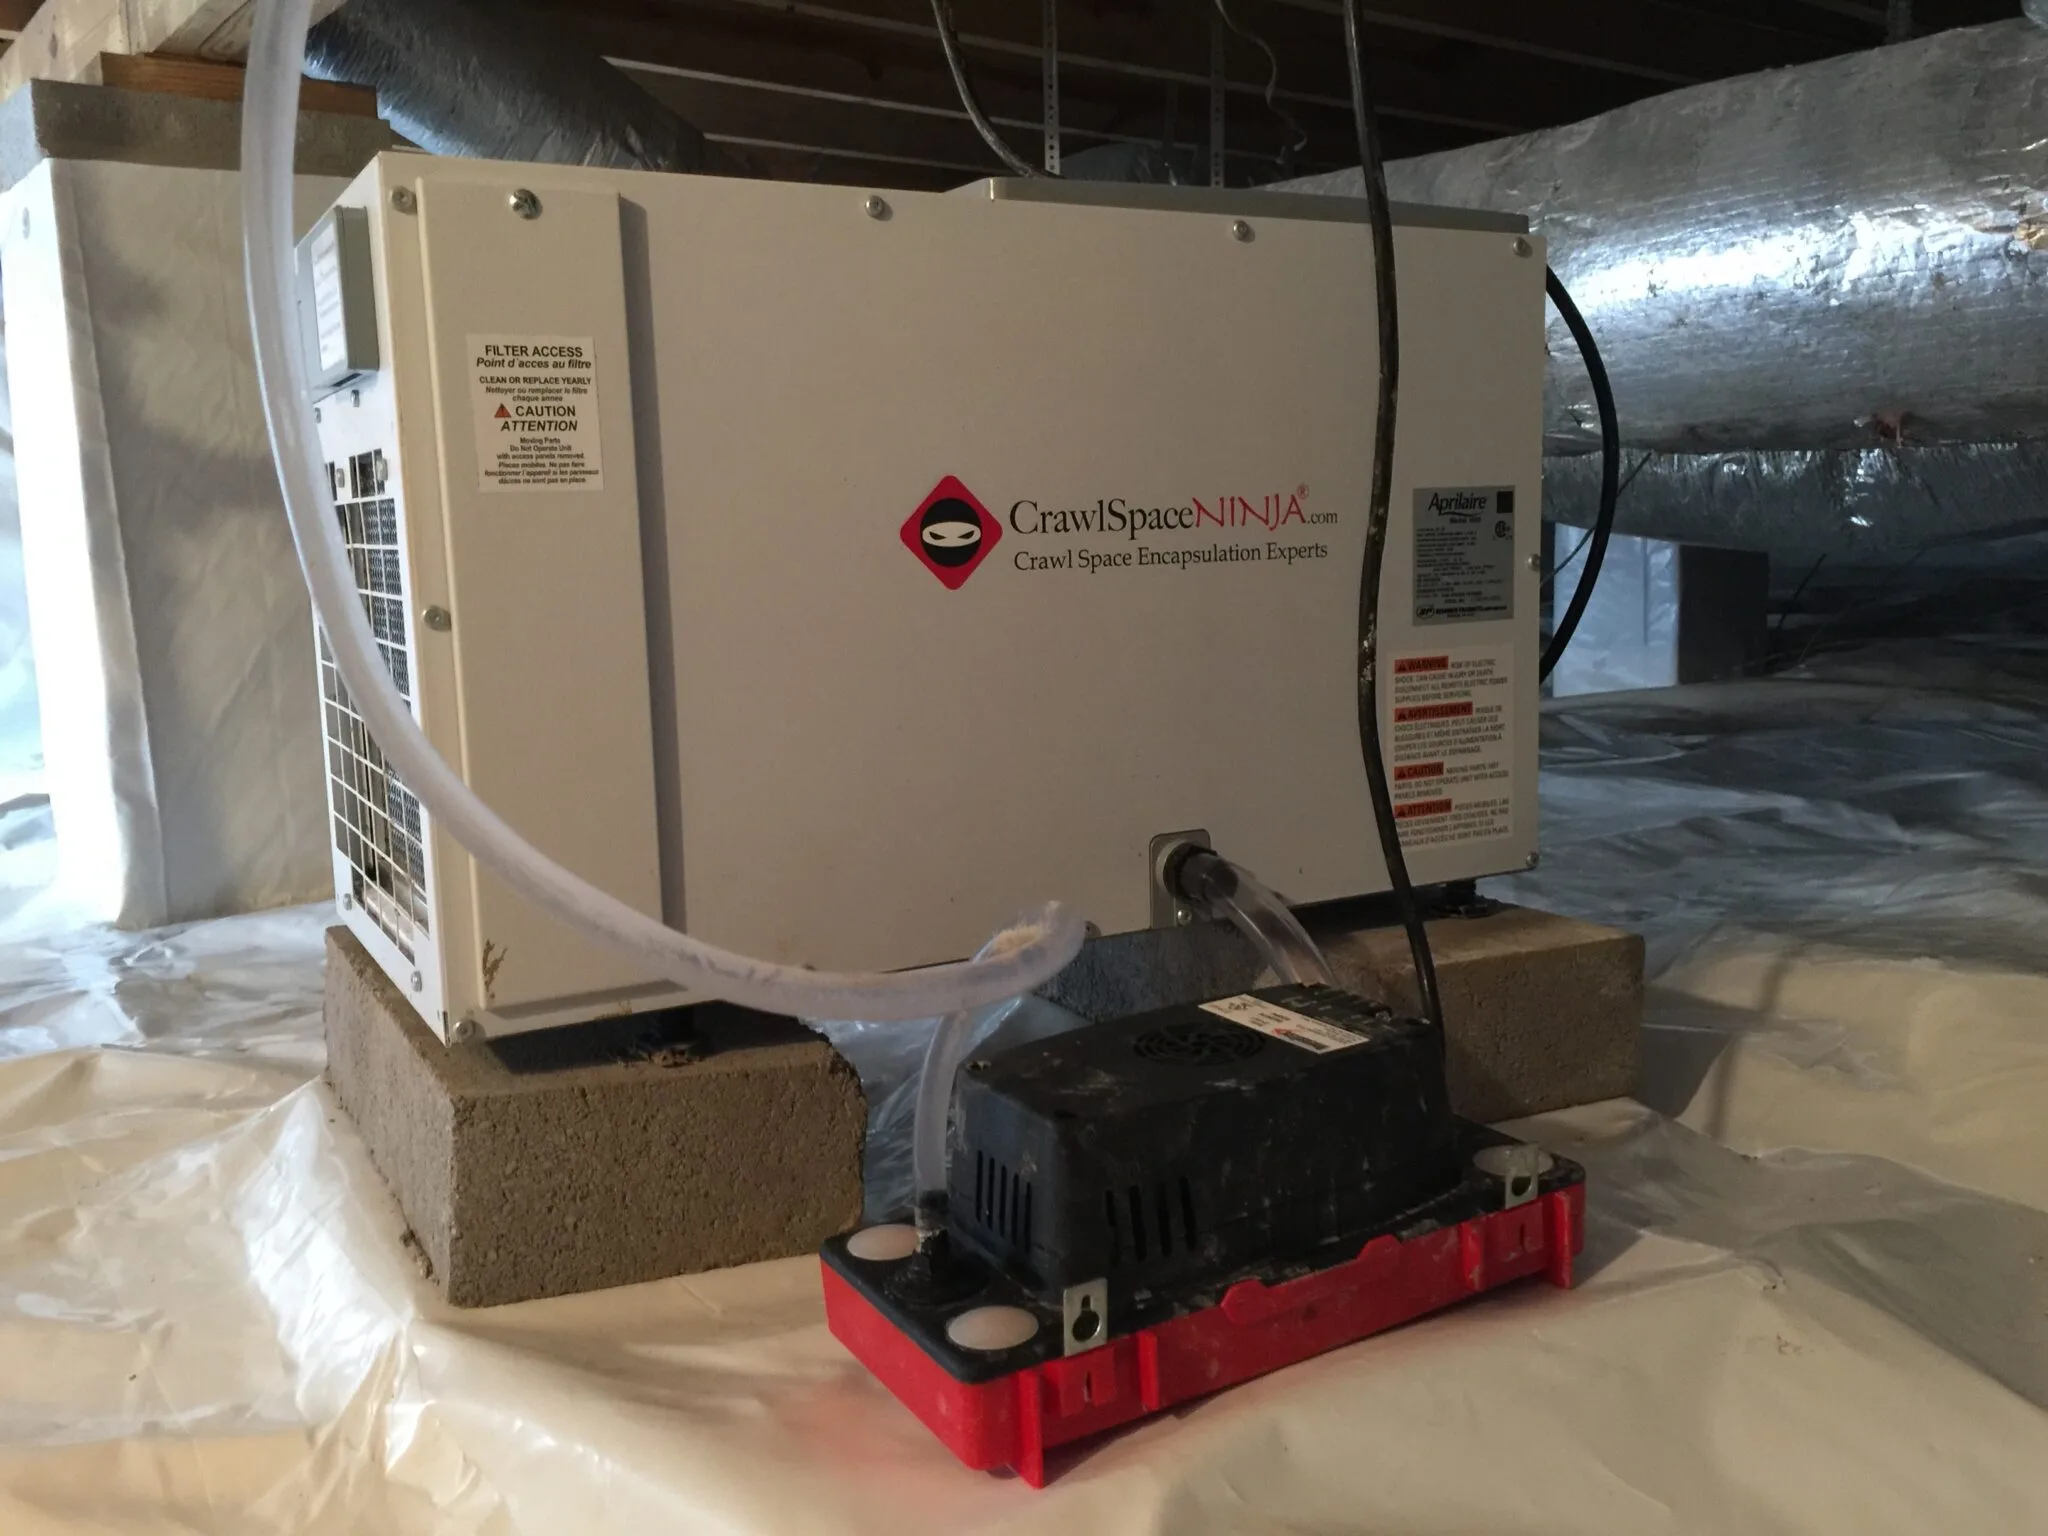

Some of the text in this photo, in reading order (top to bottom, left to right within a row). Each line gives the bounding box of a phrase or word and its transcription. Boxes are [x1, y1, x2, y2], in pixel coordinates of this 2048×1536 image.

[485, 345, 583, 357] FILTER ACCESS
[477, 358, 505, 368] Point
[553, 360, 565, 368] au
[568, 360, 591, 368] filtre
[479, 376, 507, 384] CLEAN
[509, 376, 520, 384] OR
[486, 386, 515, 394] Nettoyer
[516, 406, 576, 416] CAUTION
[501, 420, 578, 431] ATTENTION
[1428, 492, 1487, 515] Aprilaire
[1014, 542, 1328, 573] Crawl Space Encapsulation Experts
[1407, 763, 1443, 779] CAUTION
[1407, 799, 1452, 816] ATTENTION
